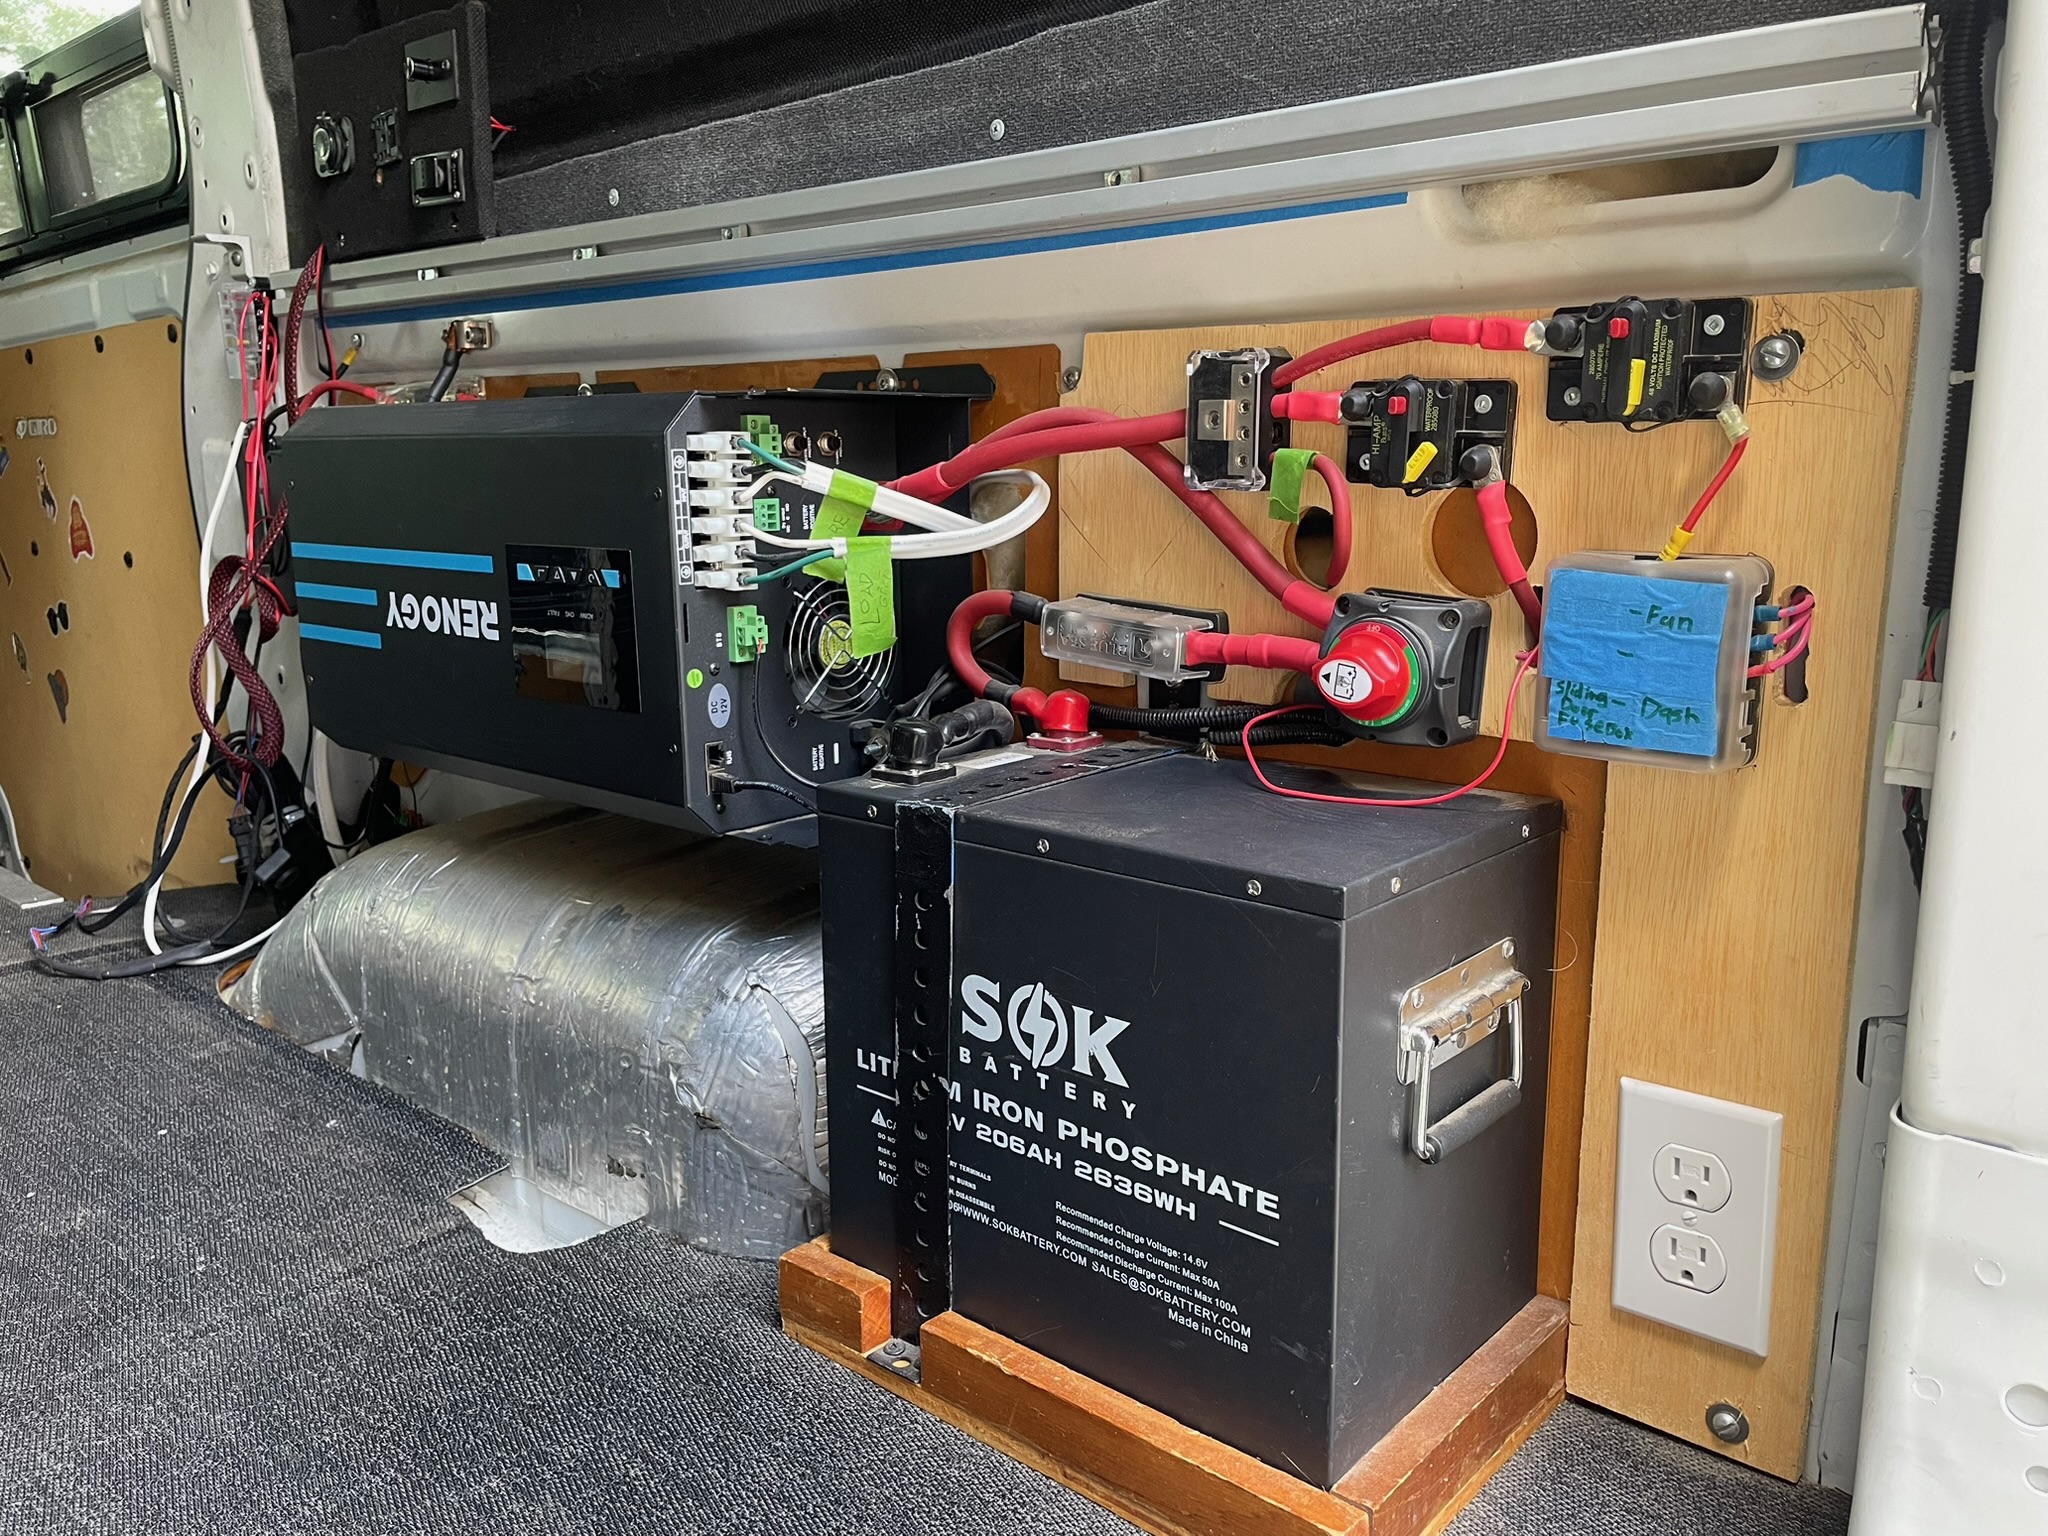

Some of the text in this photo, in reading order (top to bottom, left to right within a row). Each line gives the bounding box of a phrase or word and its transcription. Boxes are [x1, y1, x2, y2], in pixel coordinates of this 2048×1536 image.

[1597, 343, 1605, 372] AMPERE
[1656, 325, 1668, 389] IGNITION PROTECTED
[1665, 339, 1674, 376] WATERPROOF
[1424, 388, 1434, 432] WATERPROOF
[1372, 415, 1381, 455] HI-AMP
[386, 592, 499, 641] RENOGY
[859, 572, 880, 625] LOAD
[1367, 624, 1380, 632] OFF
[711, 700, 718, 714] DC
[720, 698, 728, 714] 12V
[1641, 696, 1700, 725] Dash
[961, 974, 1131, 1088] SOK
[959, 1046, 1136, 1119] BATTERY
[878, 1146, 890, 1156] RISK
[959, 1164, 992, 1182] TERMINALS
[973, 1089, 1044, 1132] IRON
[1058, 1118, 1280, 1220] PHOSPHATE
[976, 1123, 1197, 1221] 206AH 2636WH
[956, 1190, 995, 1212] DISASSEMBLE
[957, 1177, 976, 1190] BURNS
[1056, 1200, 1208, 1269] Recommended Charge Voltage: 14.6V
[1056, 1216, 1220, 1291] Recommended Charge Current: Max 50A
[1056, 1231, 1238, 1315] Recommended Discharge Current: Max 100A
[1091, 1261, 1251, 1338] SALES@SOKBATTERY.COM
[1168, 1308, 1248, 1353] Made in China
